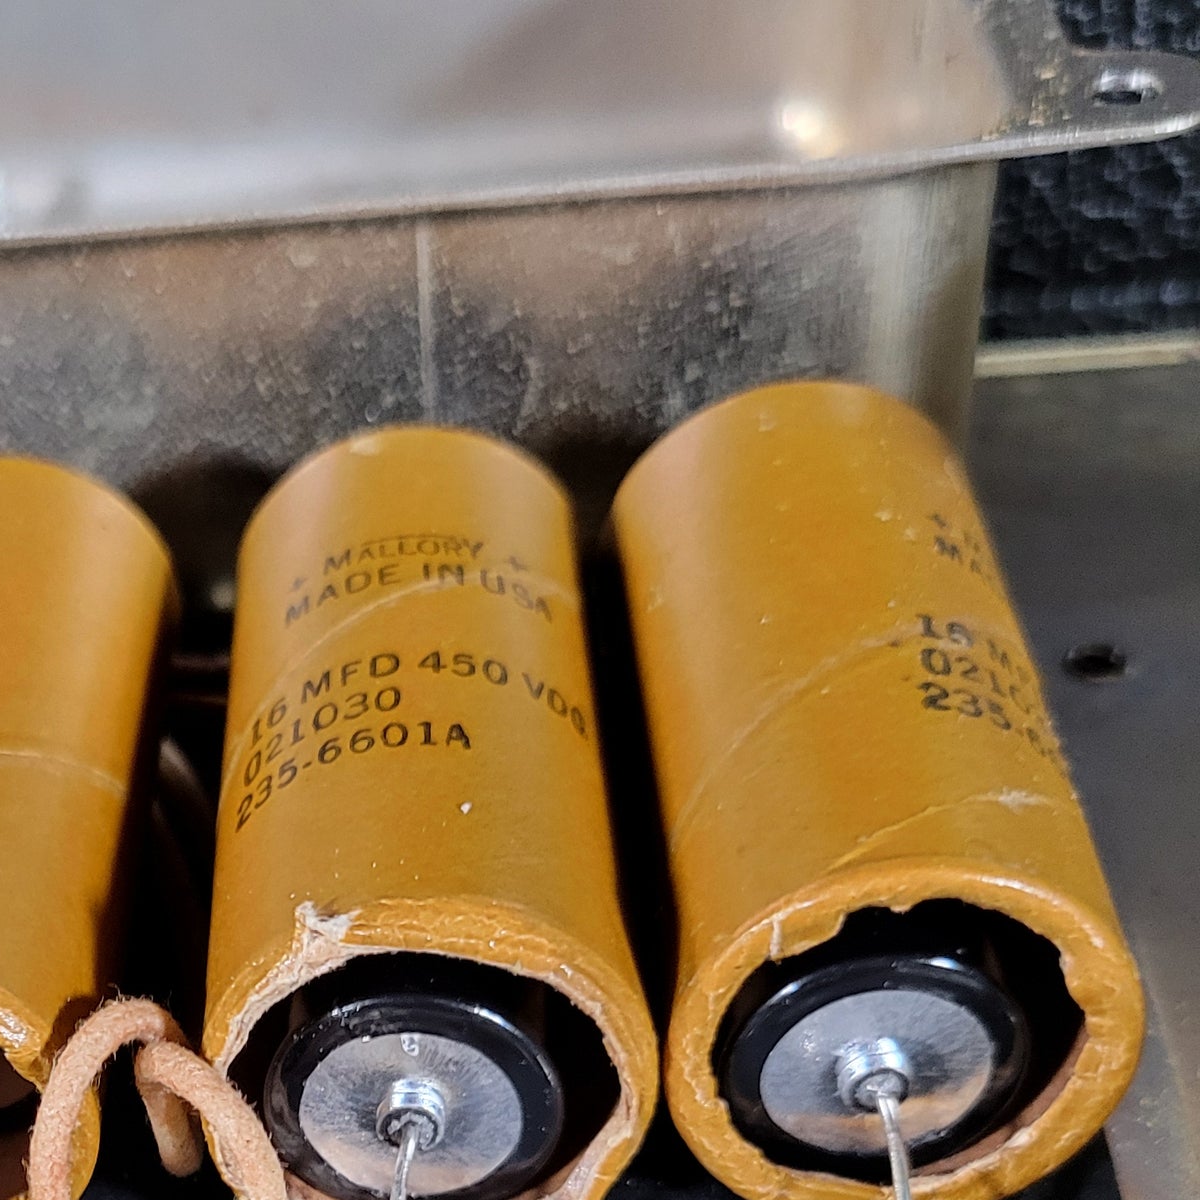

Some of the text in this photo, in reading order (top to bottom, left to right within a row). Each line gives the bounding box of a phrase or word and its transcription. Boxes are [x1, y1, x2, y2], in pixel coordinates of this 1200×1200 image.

[284, 561, 554, 628] MADE IN USA
[323, 536, 484, 575] MALLORY
[243, 685, 402, 788] 021030
[250, 695, 288, 749] 16
[299, 651, 402, 706] MFD
[417, 650, 509, 686] 450
[234, 720, 473, 834] 235-6601A
